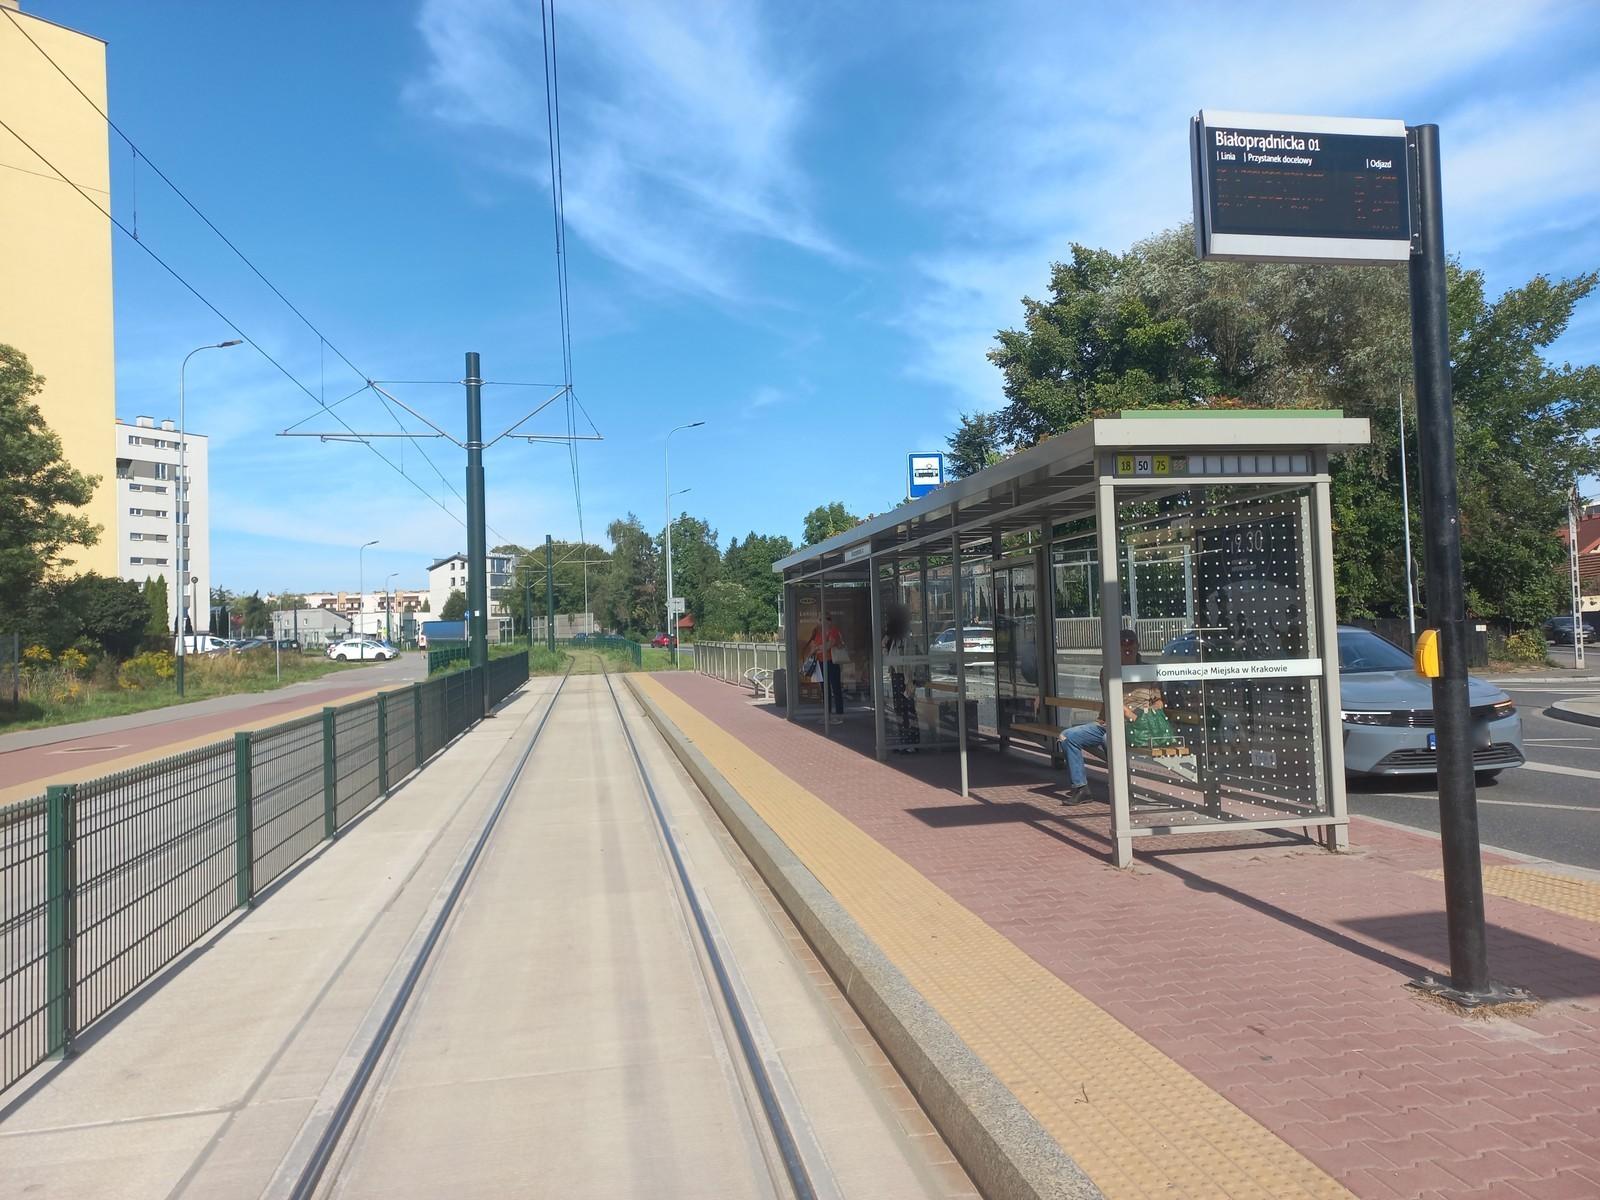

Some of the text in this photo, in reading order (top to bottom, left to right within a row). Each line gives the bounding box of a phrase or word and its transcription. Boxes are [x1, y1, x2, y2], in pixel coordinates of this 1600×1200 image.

[1216, 130, 1321, 152] Białoprądnicka 01
[1221, 151, 1236, 161] Linia
[1247, 153, 1312, 167] Przystanek docelowy
[1370, 159, 1392, 170] Odjazd
[1121, 460, 1166, 471] 18 50 75
[1156, 668, 1209, 678] Komunikacja
[1210, 666, 1240, 676] Miejska
[1251, 664, 1288, 674] Krakowie
